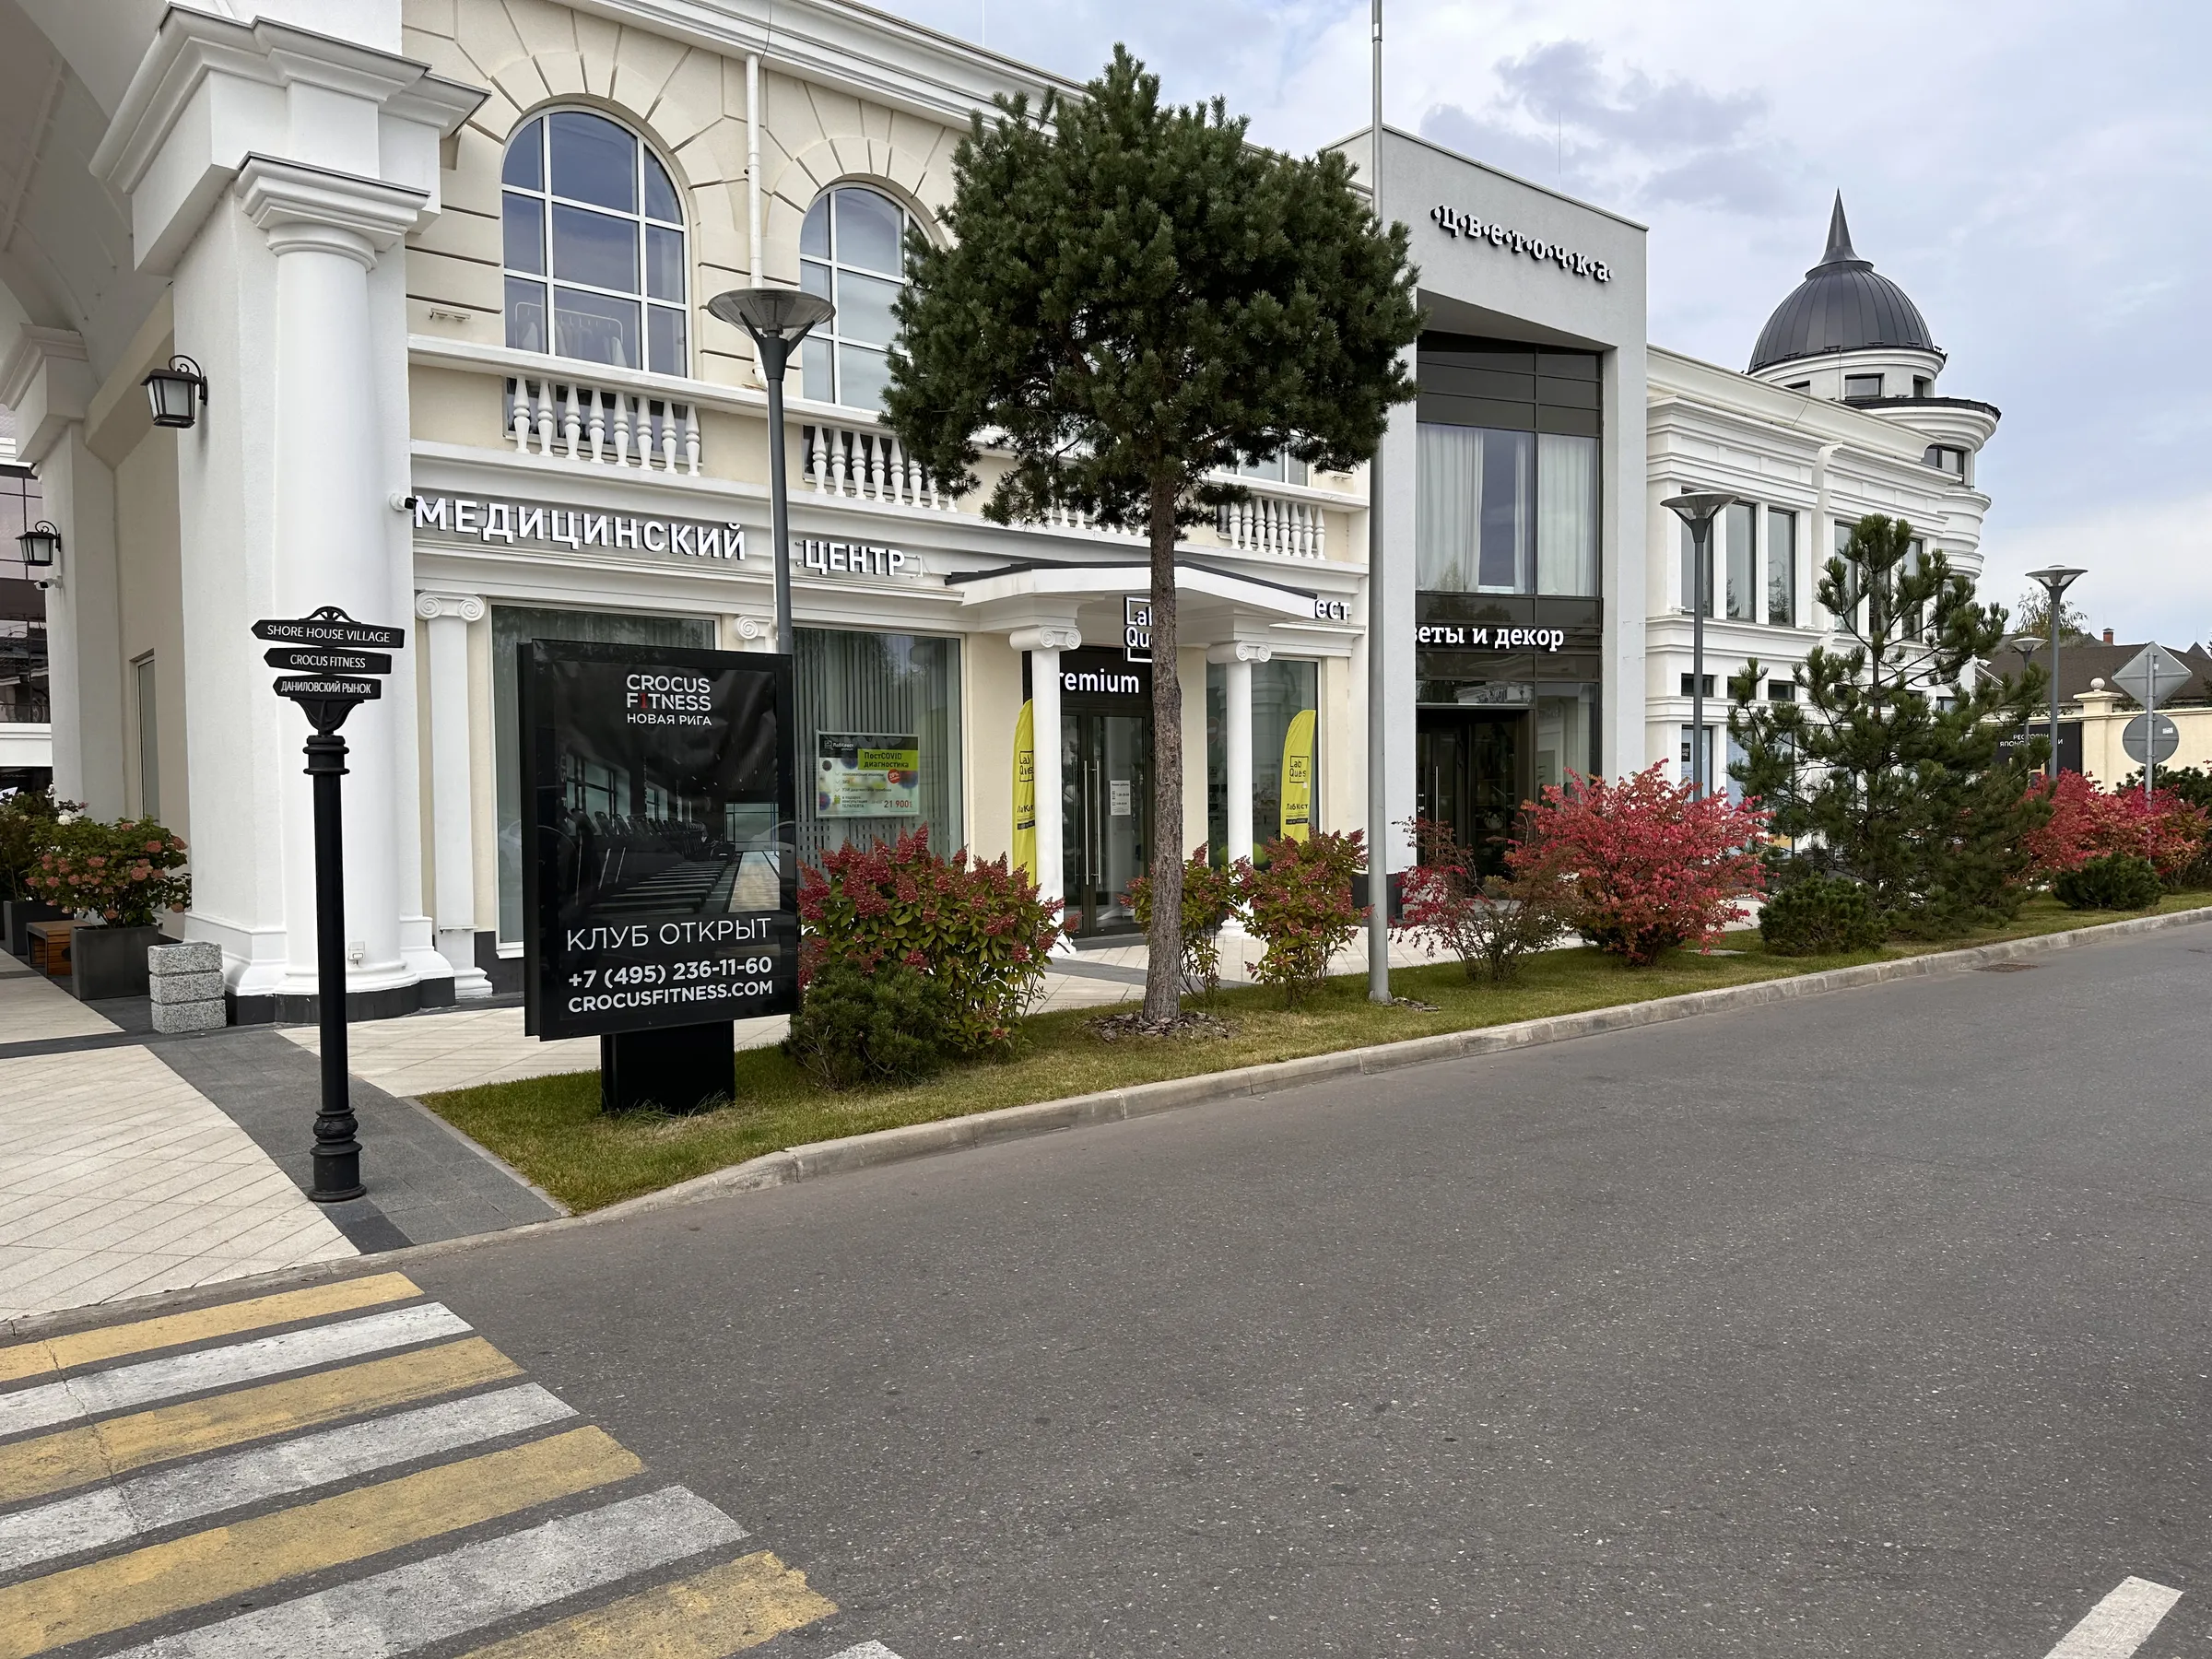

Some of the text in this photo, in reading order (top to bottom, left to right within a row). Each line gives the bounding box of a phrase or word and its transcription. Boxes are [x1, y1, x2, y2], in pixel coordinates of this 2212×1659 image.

[414, 495, 906, 576] МЕДИЦИНСКИЙ ЦЕНТР
[267, 625, 391, 643] SHORE HOUSE VILLAGE
[1472, 628, 1488, 644] и
[1494, 629, 1564, 653] декор
[290, 654, 366, 668] CROCUS FITNESS
[280, 680, 371, 694] ДАНИЛОВСКИЙ РЫНОК
[627, 674, 711, 693] CROCUS
[627, 713, 712, 725] НОВАЯ РИГА
[883, 800, 893, 808] 21
[567, 917, 771, 951] КЛУБ ОТКРЫТ
[569, 957, 772, 989] +7 (495) 236-11-60
[568, 980, 772, 1013] CROCUSFITNESS.COM
